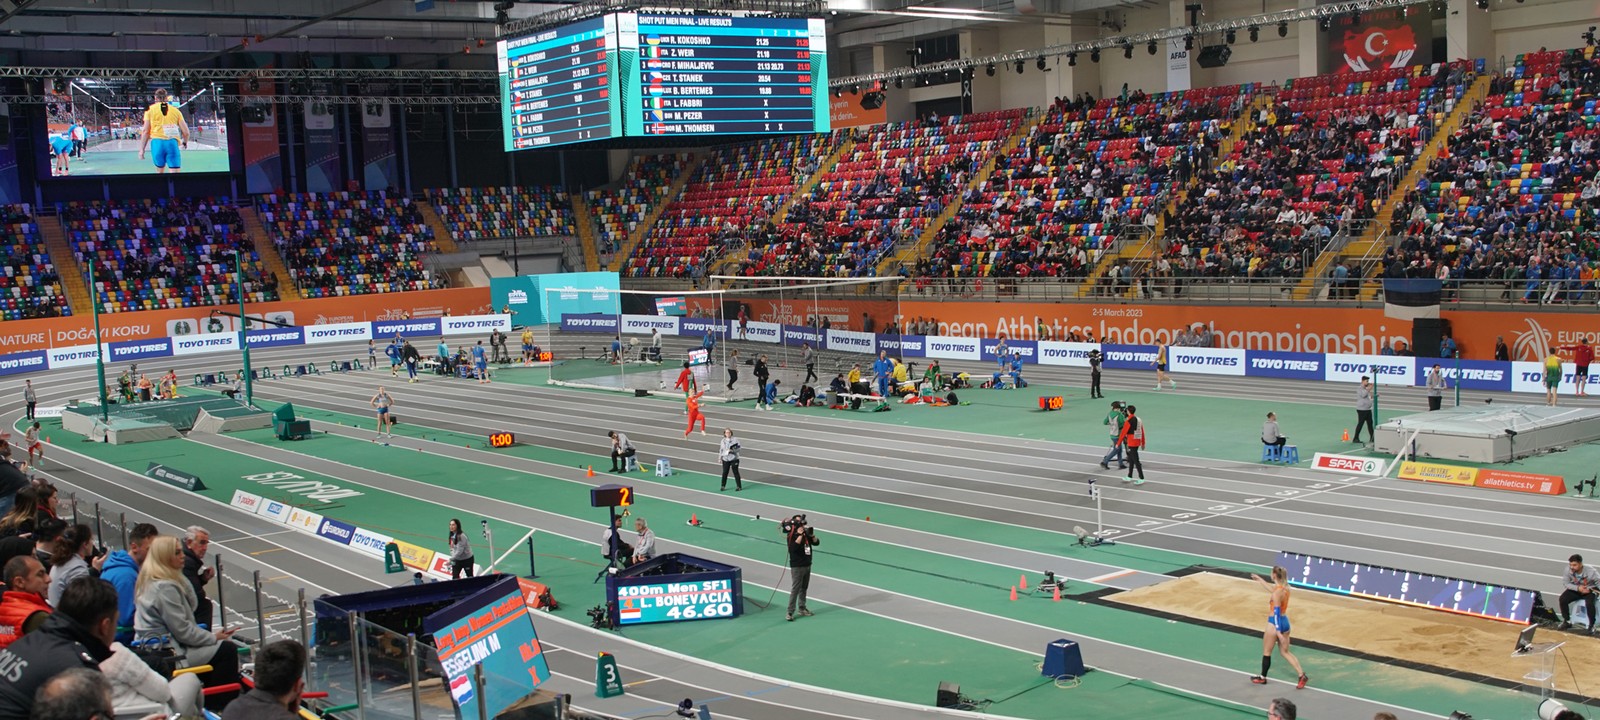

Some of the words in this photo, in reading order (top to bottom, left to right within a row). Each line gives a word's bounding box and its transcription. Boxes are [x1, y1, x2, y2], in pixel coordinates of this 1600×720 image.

[654, 17, 665, 25] PUT
[680, 18, 695, 26] FINAL
[698, 18, 709, 26] LIVE
[670, 36, 676, 44] R.
[678, 36, 711, 45] KOKOSHKO
[678, 49, 694, 57] WEIR
[1170, 51, 1186, 60] AFAD
[677, 62, 714, 70] MIHALJEVIC
[672, 74, 678, 82] T.
[679, 74, 704, 82] STANEK
[674, 112, 682, 120] M.
[684, 112, 702, 120] PEZER
[676, 124, 684, 132] M.
[684, 124, 714, 132] THOMSEN
[1092, 308, 1103, 316] 2-5
[1104, 308, 1125, 316] March
[1126, 309, 1143, 317] 2023
[448, 321, 475, 329] TOYO
[476, 319, 505, 327] TIRES
[566, 318, 591, 326] TOYO
[592, 318, 617, 327] TIRES
[627, 320, 650, 328] TOYO
[683, 323, 704, 331] TOYO
[311, 330, 339, 338] TOYO
[340, 328, 366, 336] TIRES
[377, 324, 402, 334] TOYO
[403, 322, 436, 332] TIRES
[736, 326, 756, 334] TYO
[756, 328, 776, 336] TIRES
[0, 333, 45, 346] NATURE
[112, 325, 150, 337] KORU
[246, 334, 272, 343] TOYO
[273, 332, 300, 341] TIRES
[784, 330, 802, 339] TOYO
[995, 316, 1093, 341] Athltics
[1188, 320, 1406, 356] hampionship
[178, 340, 204, 348] TOYO
[204, 338, 232, 346] TIRES
[832, 336, 850, 344] TOYO
[850, 338, 871, 346] TIRES
[879, 340, 900, 349] TOYO
[900, 342, 922, 350] TIRES
[114, 346, 140, 356] TOYO
[140, 343, 168, 352] TIRES
[930, 342, 950, 351] TOYO
[951, 344, 975, 352] TIRES
[1008, 346, 1034, 356] TIRES
[54, 352, 78, 362] TOYO
[1044, 348, 1066, 357] TOYO
[1106, 351, 1132, 360] TOYO
[1132, 352, 1158, 362] TIRE
[0, 360, 18, 369] OYO
[19, 356, 44, 366] TIRES
[1176, 355, 1204, 364] TOYO
[1206, 356, 1238, 366] TIRES
[1252, 358, 1282, 369] TOYO
[1283, 360, 1318, 372] TIRES
[1334, 363, 1368, 373] TOYO
[1423, 366, 1460, 379] TYO
[1462, 368, 1504, 381] TIRES
[1048, 396, 1064, 409] 1:00
[490, 433, 512, 447] 1:00
[1328, 458, 1362, 470] SPAR
[1484, 477, 1535, 490] allathletics.tv
[620, 488, 630, 506] 2
[353, 534, 370, 547] TOYO
[388, 550, 396, 564] 1
[1303, 566, 1311, 576] 3
[1350, 574, 1358, 584] 4
[618, 586, 664, 596] 400m
[668, 583, 698, 593] Men
[703, 580, 728, 590] SF1
[1401, 582, 1408, 592] 5
[624, 598, 634, 608] 4
[640, 597, 652, 608] L.
[656, 592, 732, 608] BONEVACIA
[1454, 591, 1462, 602] 6
[1511, 600, 1520, 610] 7
[666, 603, 733, 618] 46.60
[434, 633, 456, 652] Long
[488, 632, 502, 653] M
[528, 666, 541, 686] X
[604, 664, 616, 682] 3
